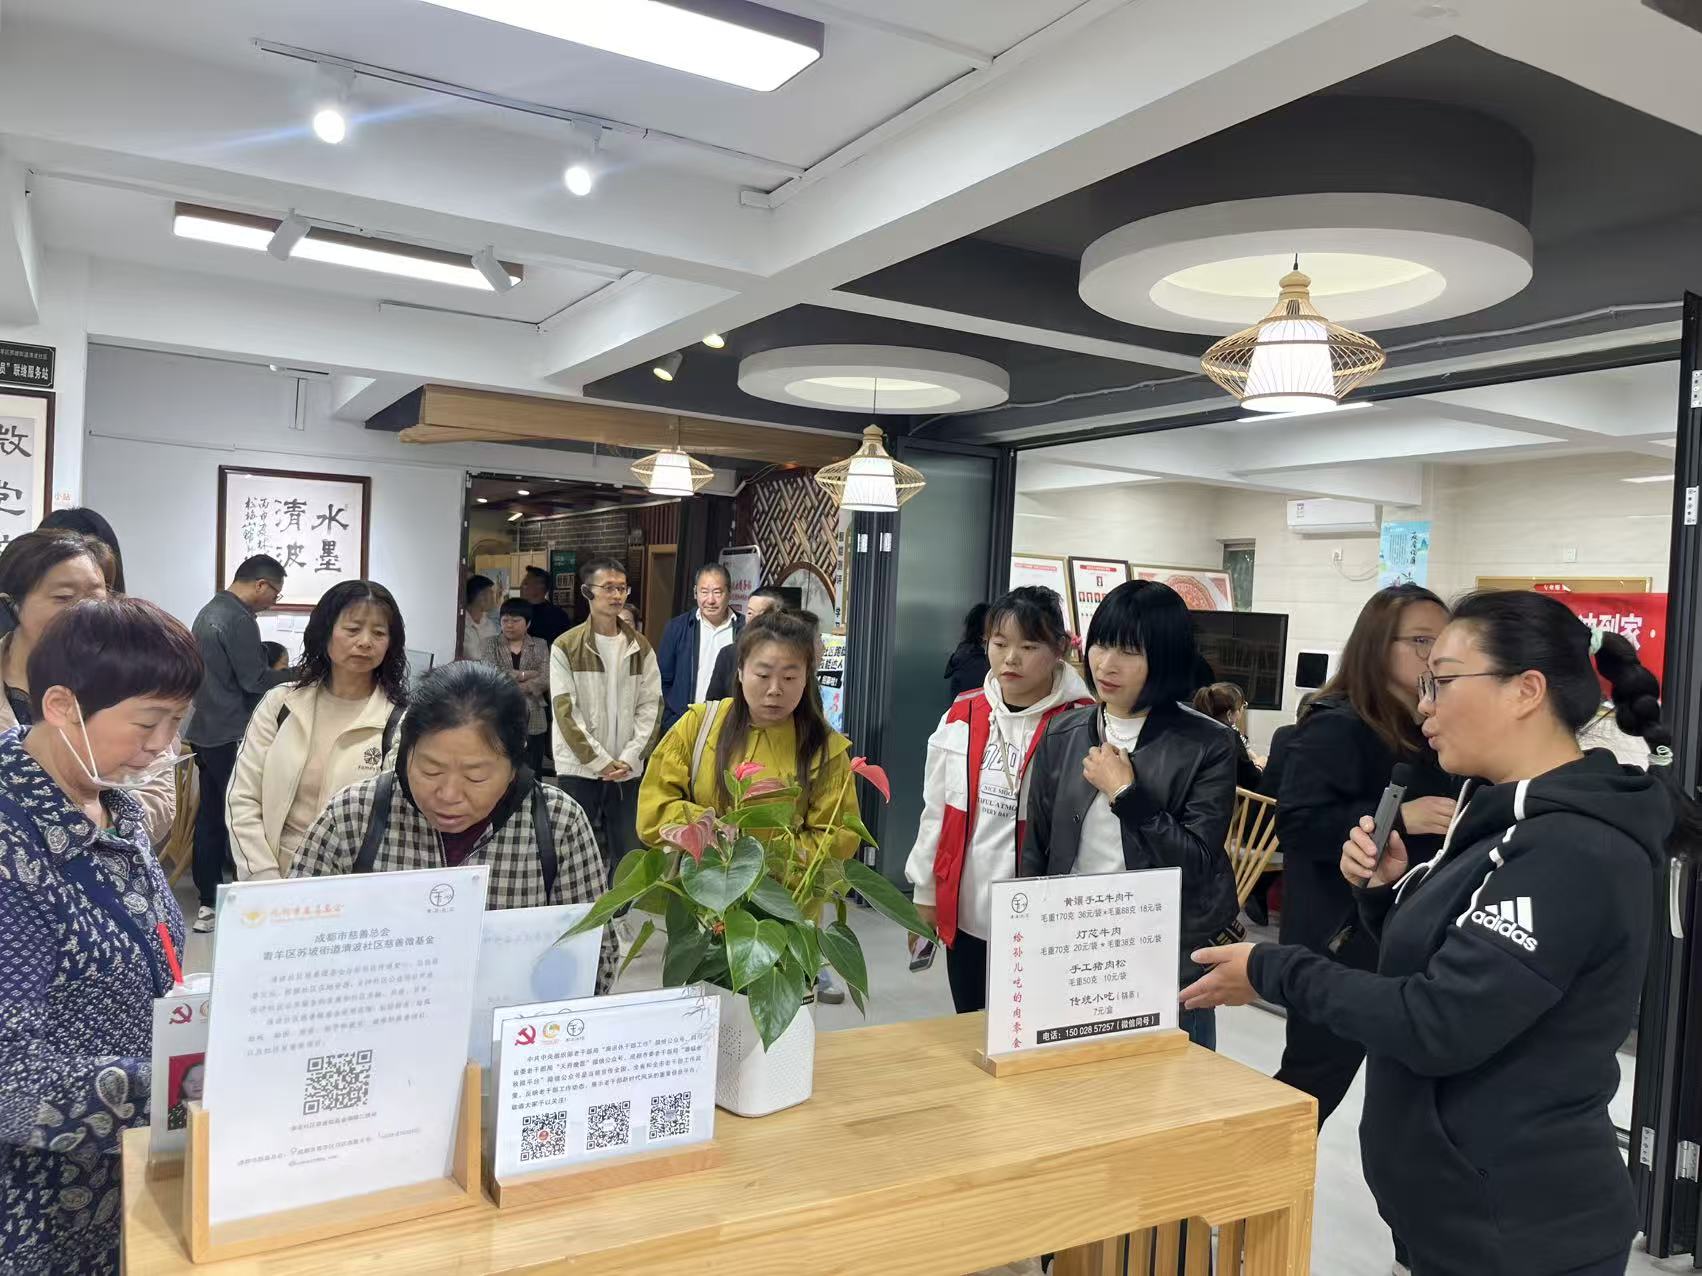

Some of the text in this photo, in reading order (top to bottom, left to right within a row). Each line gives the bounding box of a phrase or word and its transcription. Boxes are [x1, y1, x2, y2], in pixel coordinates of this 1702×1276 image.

[311, 503, 349, 573] 水墨
[314, 928, 391, 944] 成都市慈善总会
[1076, 926, 1121, 940] 灯芯牛肉
[1471, 908, 1538, 952] adidas
[1070, 959, 1127, 974] 手工猪肉松
[1065, 1028, 1079, 1037] 150
